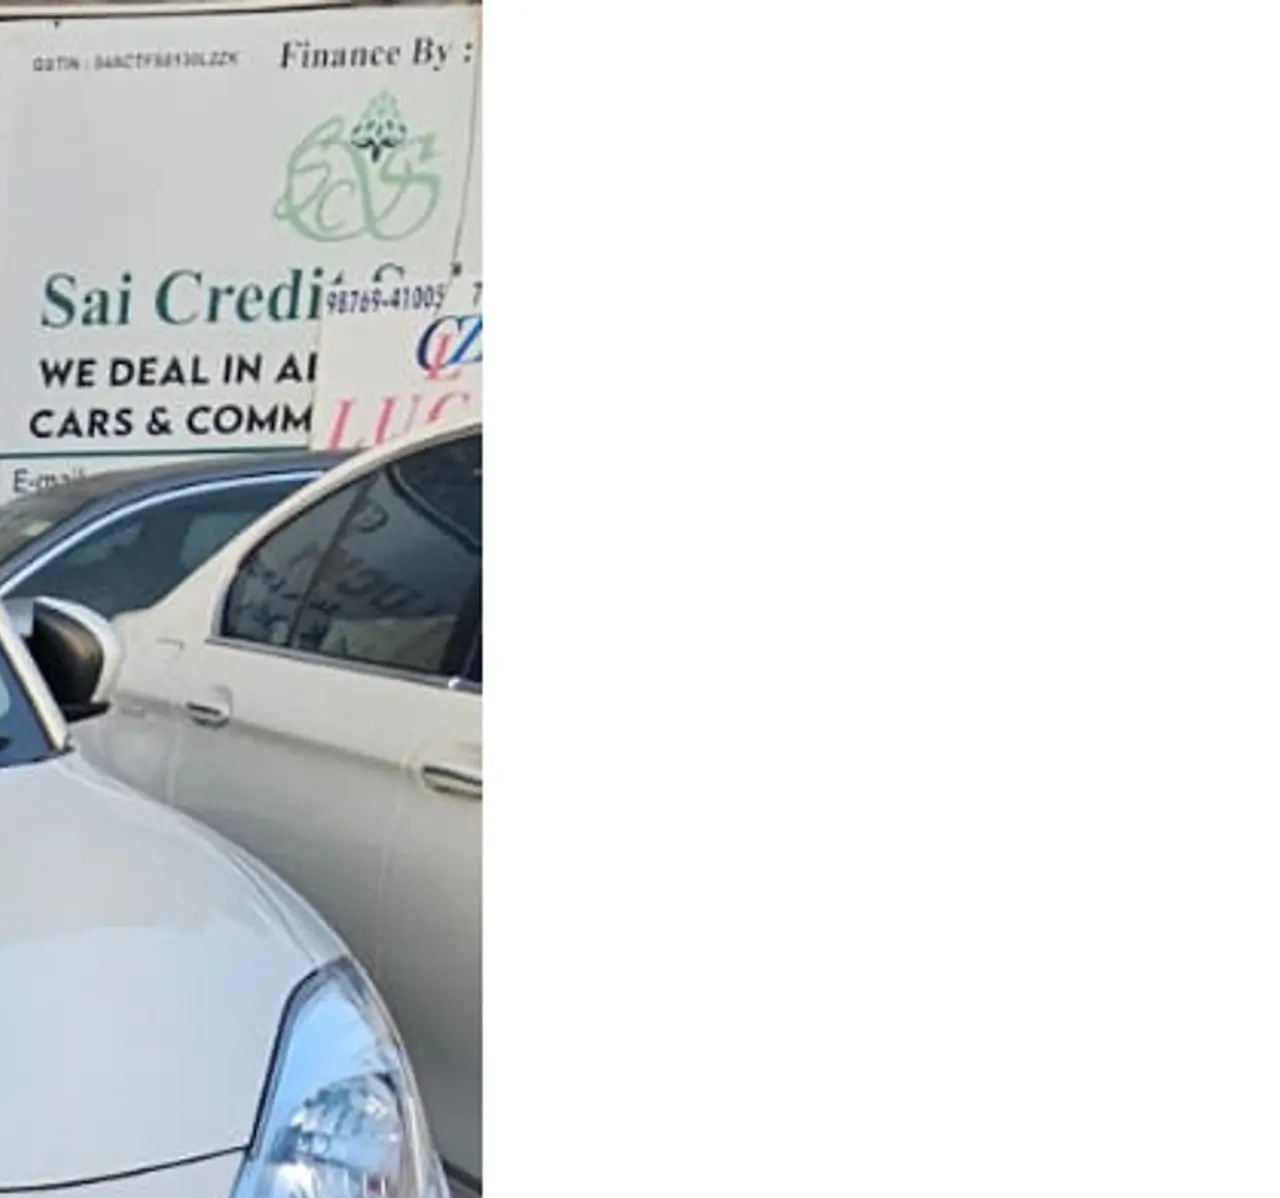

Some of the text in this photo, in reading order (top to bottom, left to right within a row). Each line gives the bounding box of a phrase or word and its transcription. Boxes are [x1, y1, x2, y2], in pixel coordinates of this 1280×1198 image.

[279, 38, 402, 69] Finance
[413, 36, 453, 72] By
[40, 265, 343, 328] Sai Credi
[39, 357, 97, 388] WE
[109, 355, 211, 388] DEAL
[223, 353, 262, 385] IN
[29, 402, 313, 439] CARS & COMM
